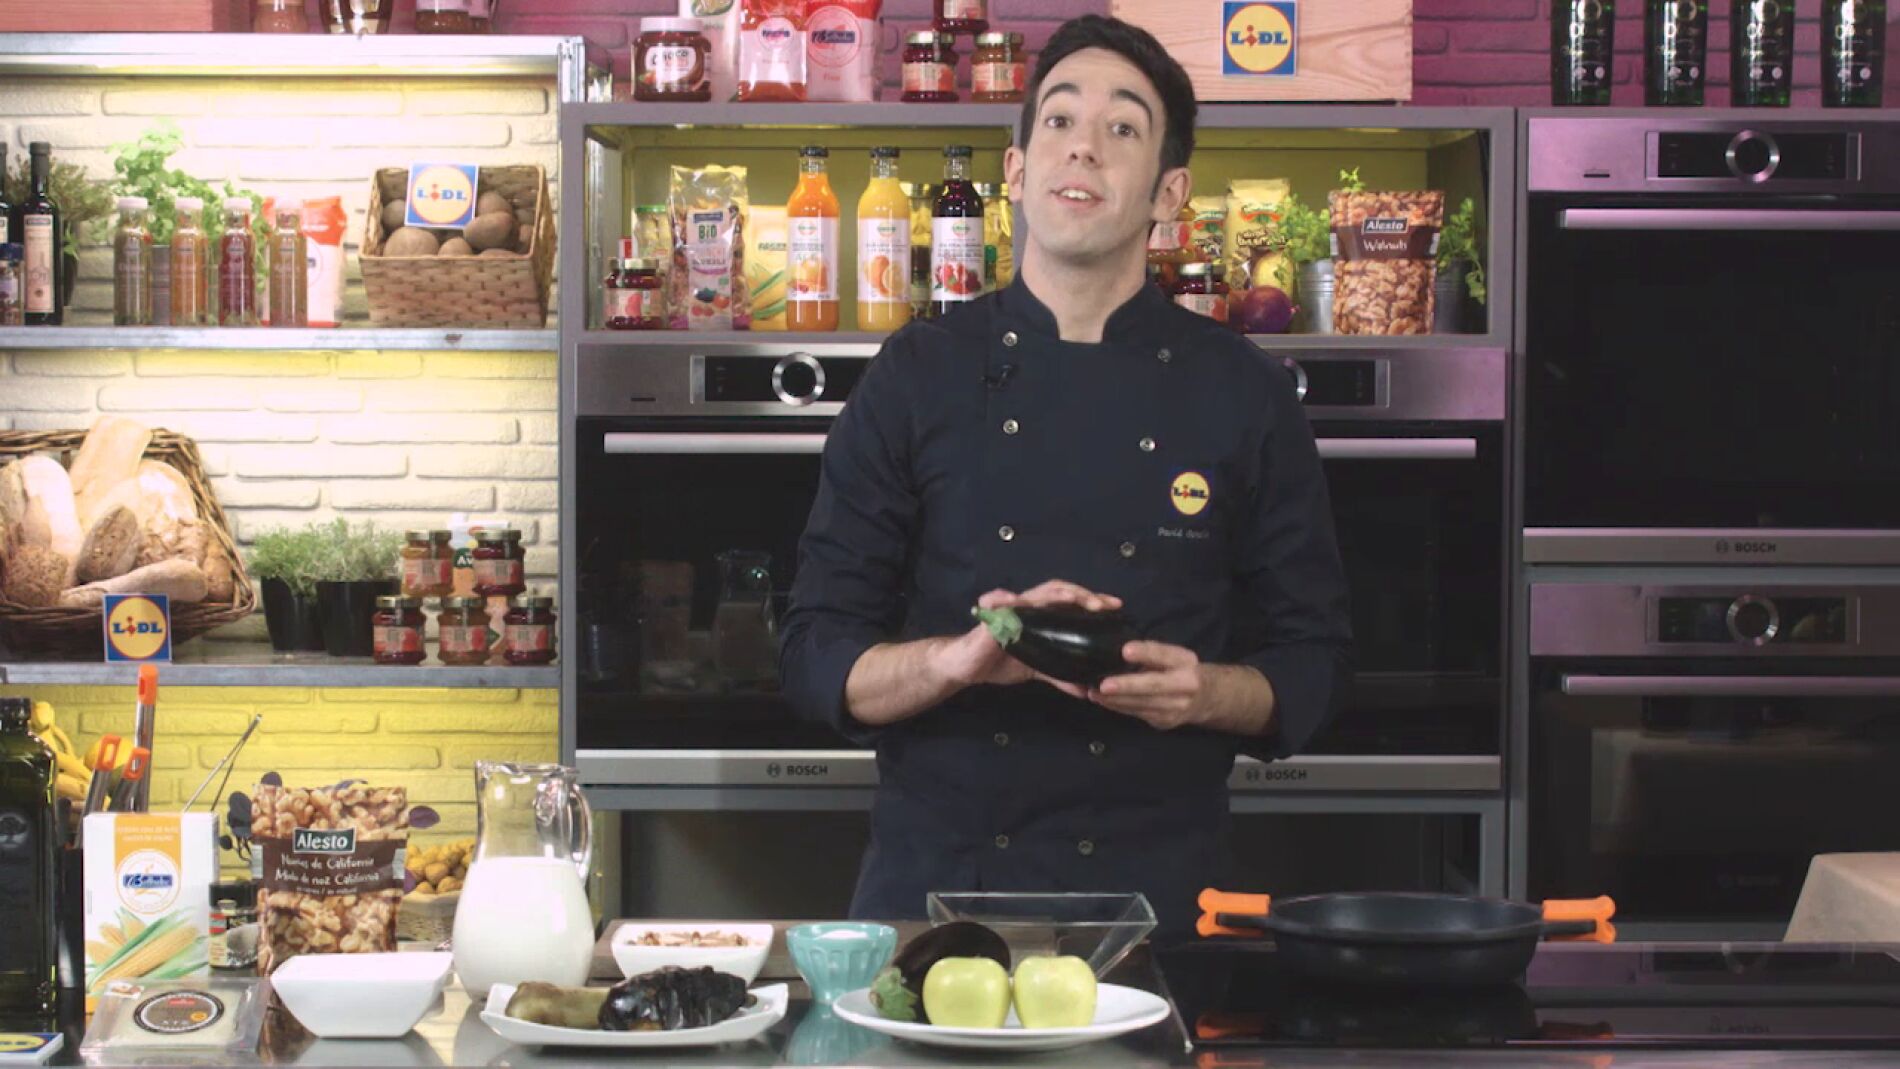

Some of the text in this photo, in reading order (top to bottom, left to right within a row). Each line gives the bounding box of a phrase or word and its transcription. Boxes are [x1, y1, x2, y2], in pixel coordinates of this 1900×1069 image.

[1366, 219, 1405, 231] Alesto
[1735, 541, 1777, 553] BOSCH
[786, 764, 829, 776] BOSCH
[1265, 768, 1307, 781] BOSCH
[296, 832, 348, 850] Alesto
